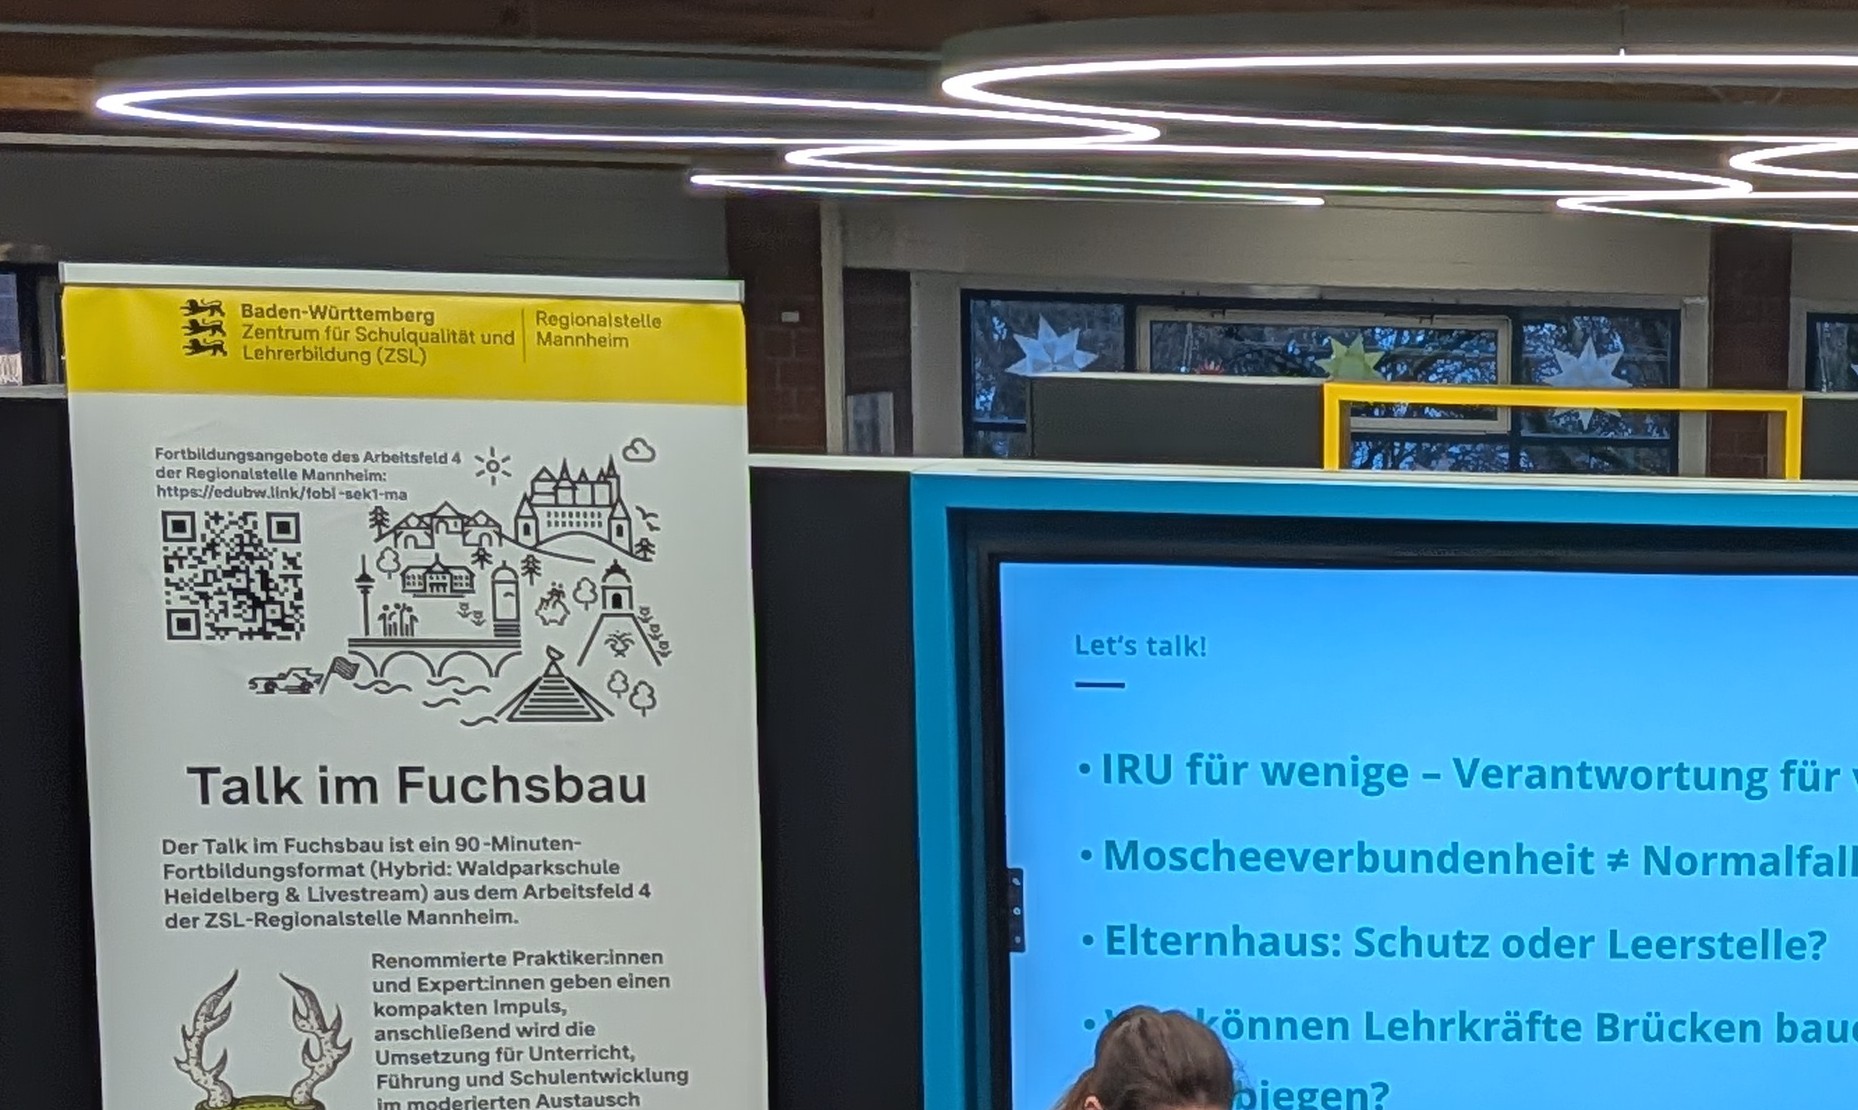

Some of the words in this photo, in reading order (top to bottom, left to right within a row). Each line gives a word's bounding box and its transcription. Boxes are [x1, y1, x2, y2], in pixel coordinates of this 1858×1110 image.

[241, 303, 434, 326] Baden-Württemberg
[536, 310, 661, 330] Regionalstelle
[242, 324, 319, 341] Zentrum
[325, 325, 350, 342] für
[356, 326, 475, 347] Schulqualität
[481, 329, 514, 345] und
[537, 330, 628, 348] Mannheim
[243, 344, 371, 367] Lehrerbildung
[377, 345, 426, 367] (ZSL)
[156, 447, 328, 465] Fortbildungsangebote
[332, 450, 360, 464] des
[363, 450, 447, 465] Arbeitsfeld
[452, 451, 461, 465] 4
[156, 466, 182, 479] der
[187, 466, 297, 483] Regionalstelle
[302, 468, 386, 482] Mannheim:
[1147, 634, 1206, 657] talk!
[187, 765, 303, 805] Talk
[319, 765, 378, 804] im
[399, 765, 645, 804] Fuchsbau
[1104, 753, 1171, 785] IRU
[1186, 752, 1248, 786] für
[1261, 754, 1408, 796] wenige
[1453, 757, 1768, 799] Verantwortung
[1780, 759, 1840, 792] für
[163, 839, 199, 856] Der
[203, 838, 247, 855] Talk
[254, 838, 277, 855] im
[284, 837, 383, 854] Fuchsbau
[390, 836, 414, 853] ist
[419, 836, 449, 853] ein
[455, 835, 581, 853] 90-Minuten-
[1105, 838, 1594, 875] Moscheeverbundenheit
[1644, 844, 1858, 878] Normalfall
[164, 862, 365, 882] Fortbildungsformat
[371, 860, 452, 880] (Hybrid:
[457, 859, 620, 880] Waldparkschule
[165, 887, 279, 907] Heidelberg
[286, 886, 300, 903] &
[308, 884, 428, 904] Livestream)
[434, 888, 470, 901] aus
[474, 884, 517, 900] dem
[523, 883, 633, 900] Arbeitsfeld
[639, 882, 651, 899] 4
[165, 912, 200, 929] der
[205, 910, 401, 931] ZSL-Regionalstelle
[407, 908, 518, 925] Mannheim.
[1107, 923, 1340, 957] Elternhaus:
[1355, 925, 1489, 958] Schutz
[1503, 926, 1595, 959] oder
[1610, 928, 1826, 960] Leerstelle?
[372, 951, 506, 969] Renommierte
[513, 949, 663, 967] Praktiker:innen
[373, 976, 411, 993] und
[418, 975, 544, 994] Expert:innen
[550, 974, 611, 993] geben
[617, 972, 670, 989] einen
[374, 1000, 487, 1021] kompakten
[494, 998, 567, 1018] Impuls,
[375, 1022, 510, 1041] anschließend
[516, 1021, 559, 1038] wird
[566, 1021, 595, 1037] die
[1366, 1008, 1581, 1042] Lehrkräfte
[1597, 1011, 1760, 1043] Brücken
[376, 1049, 489, 1067] Umsetzung
[496, 1046, 524, 1063] für
[529, 1044, 635, 1063] Unterricht,
[377, 1073, 460, 1092] Führung
[466, 1070, 504, 1087] und
[510, 1067, 688, 1087] Schulentwicklung
[536, 1091, 640, 1109] Austausch
